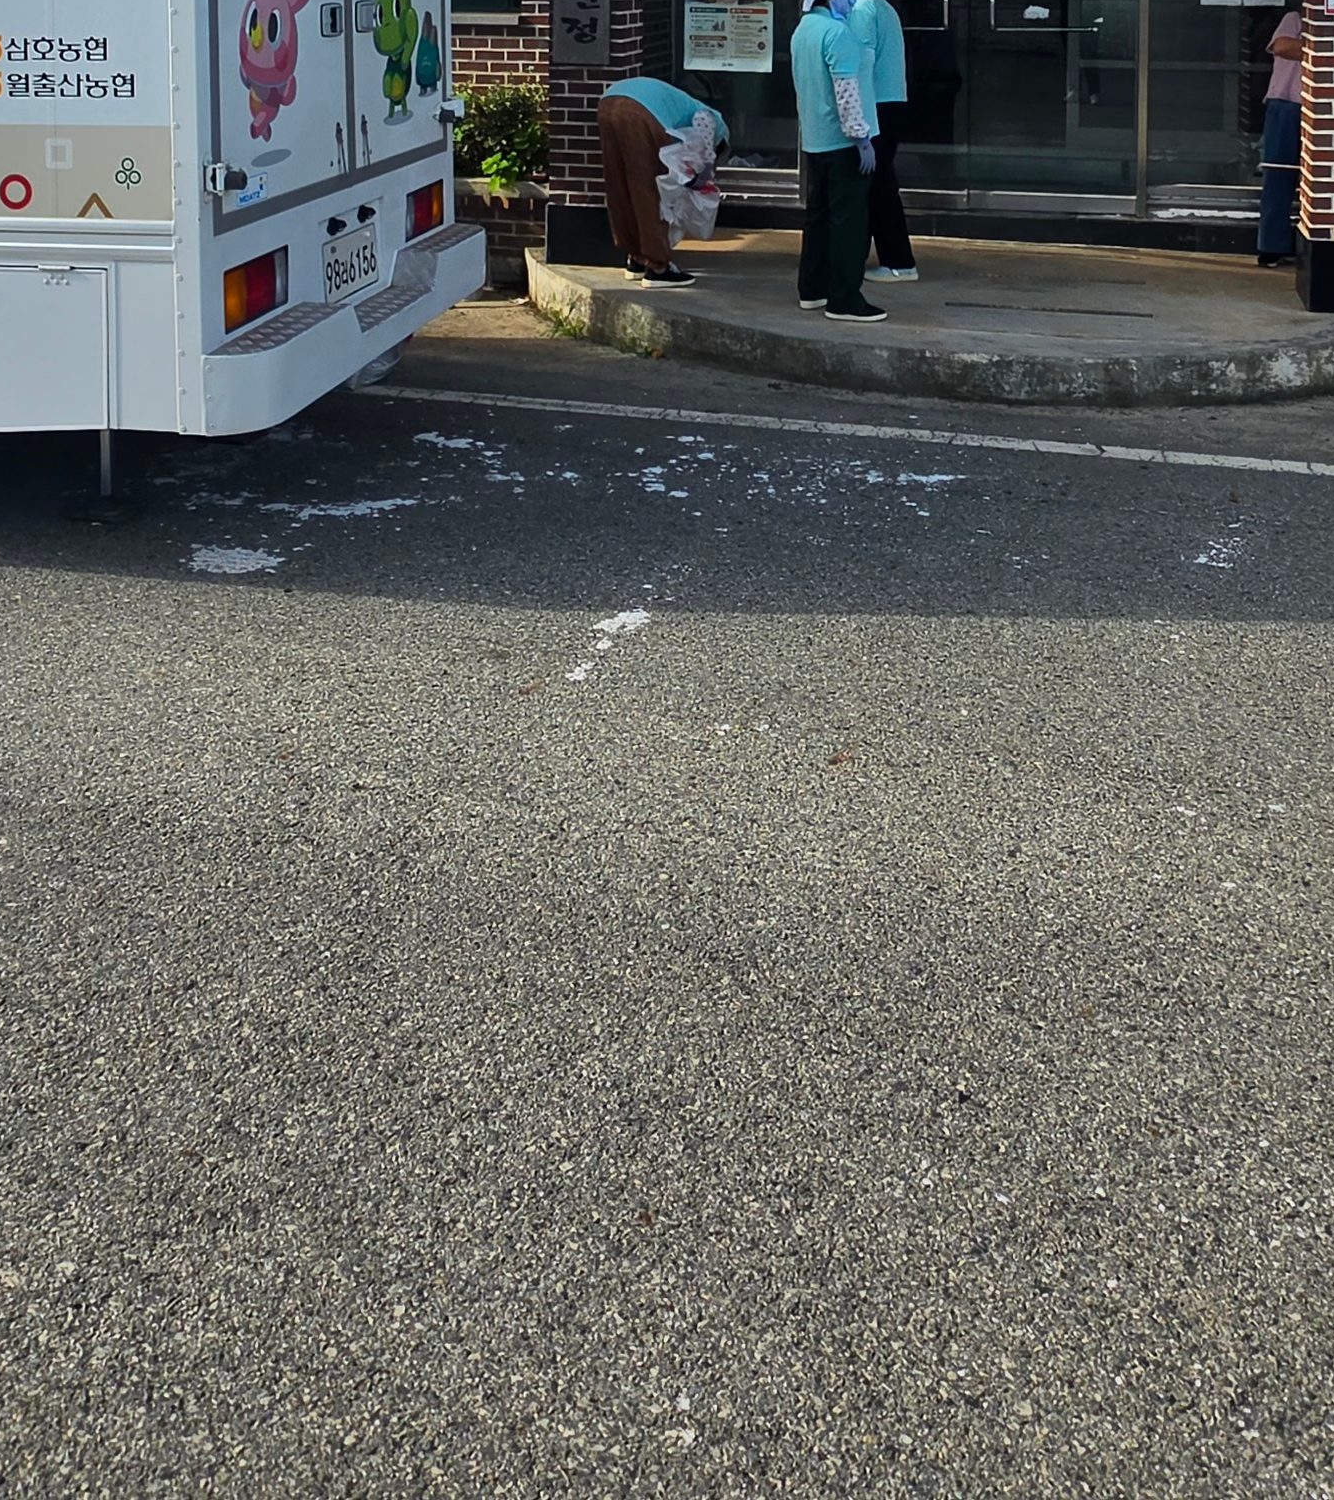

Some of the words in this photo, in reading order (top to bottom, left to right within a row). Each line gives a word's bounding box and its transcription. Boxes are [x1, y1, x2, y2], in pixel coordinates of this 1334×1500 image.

[4, 37, 108, 63] 삼호농협
[7, 72, 136, 98] 월출산농협
[325, 241, 377, 295] 98러6156
